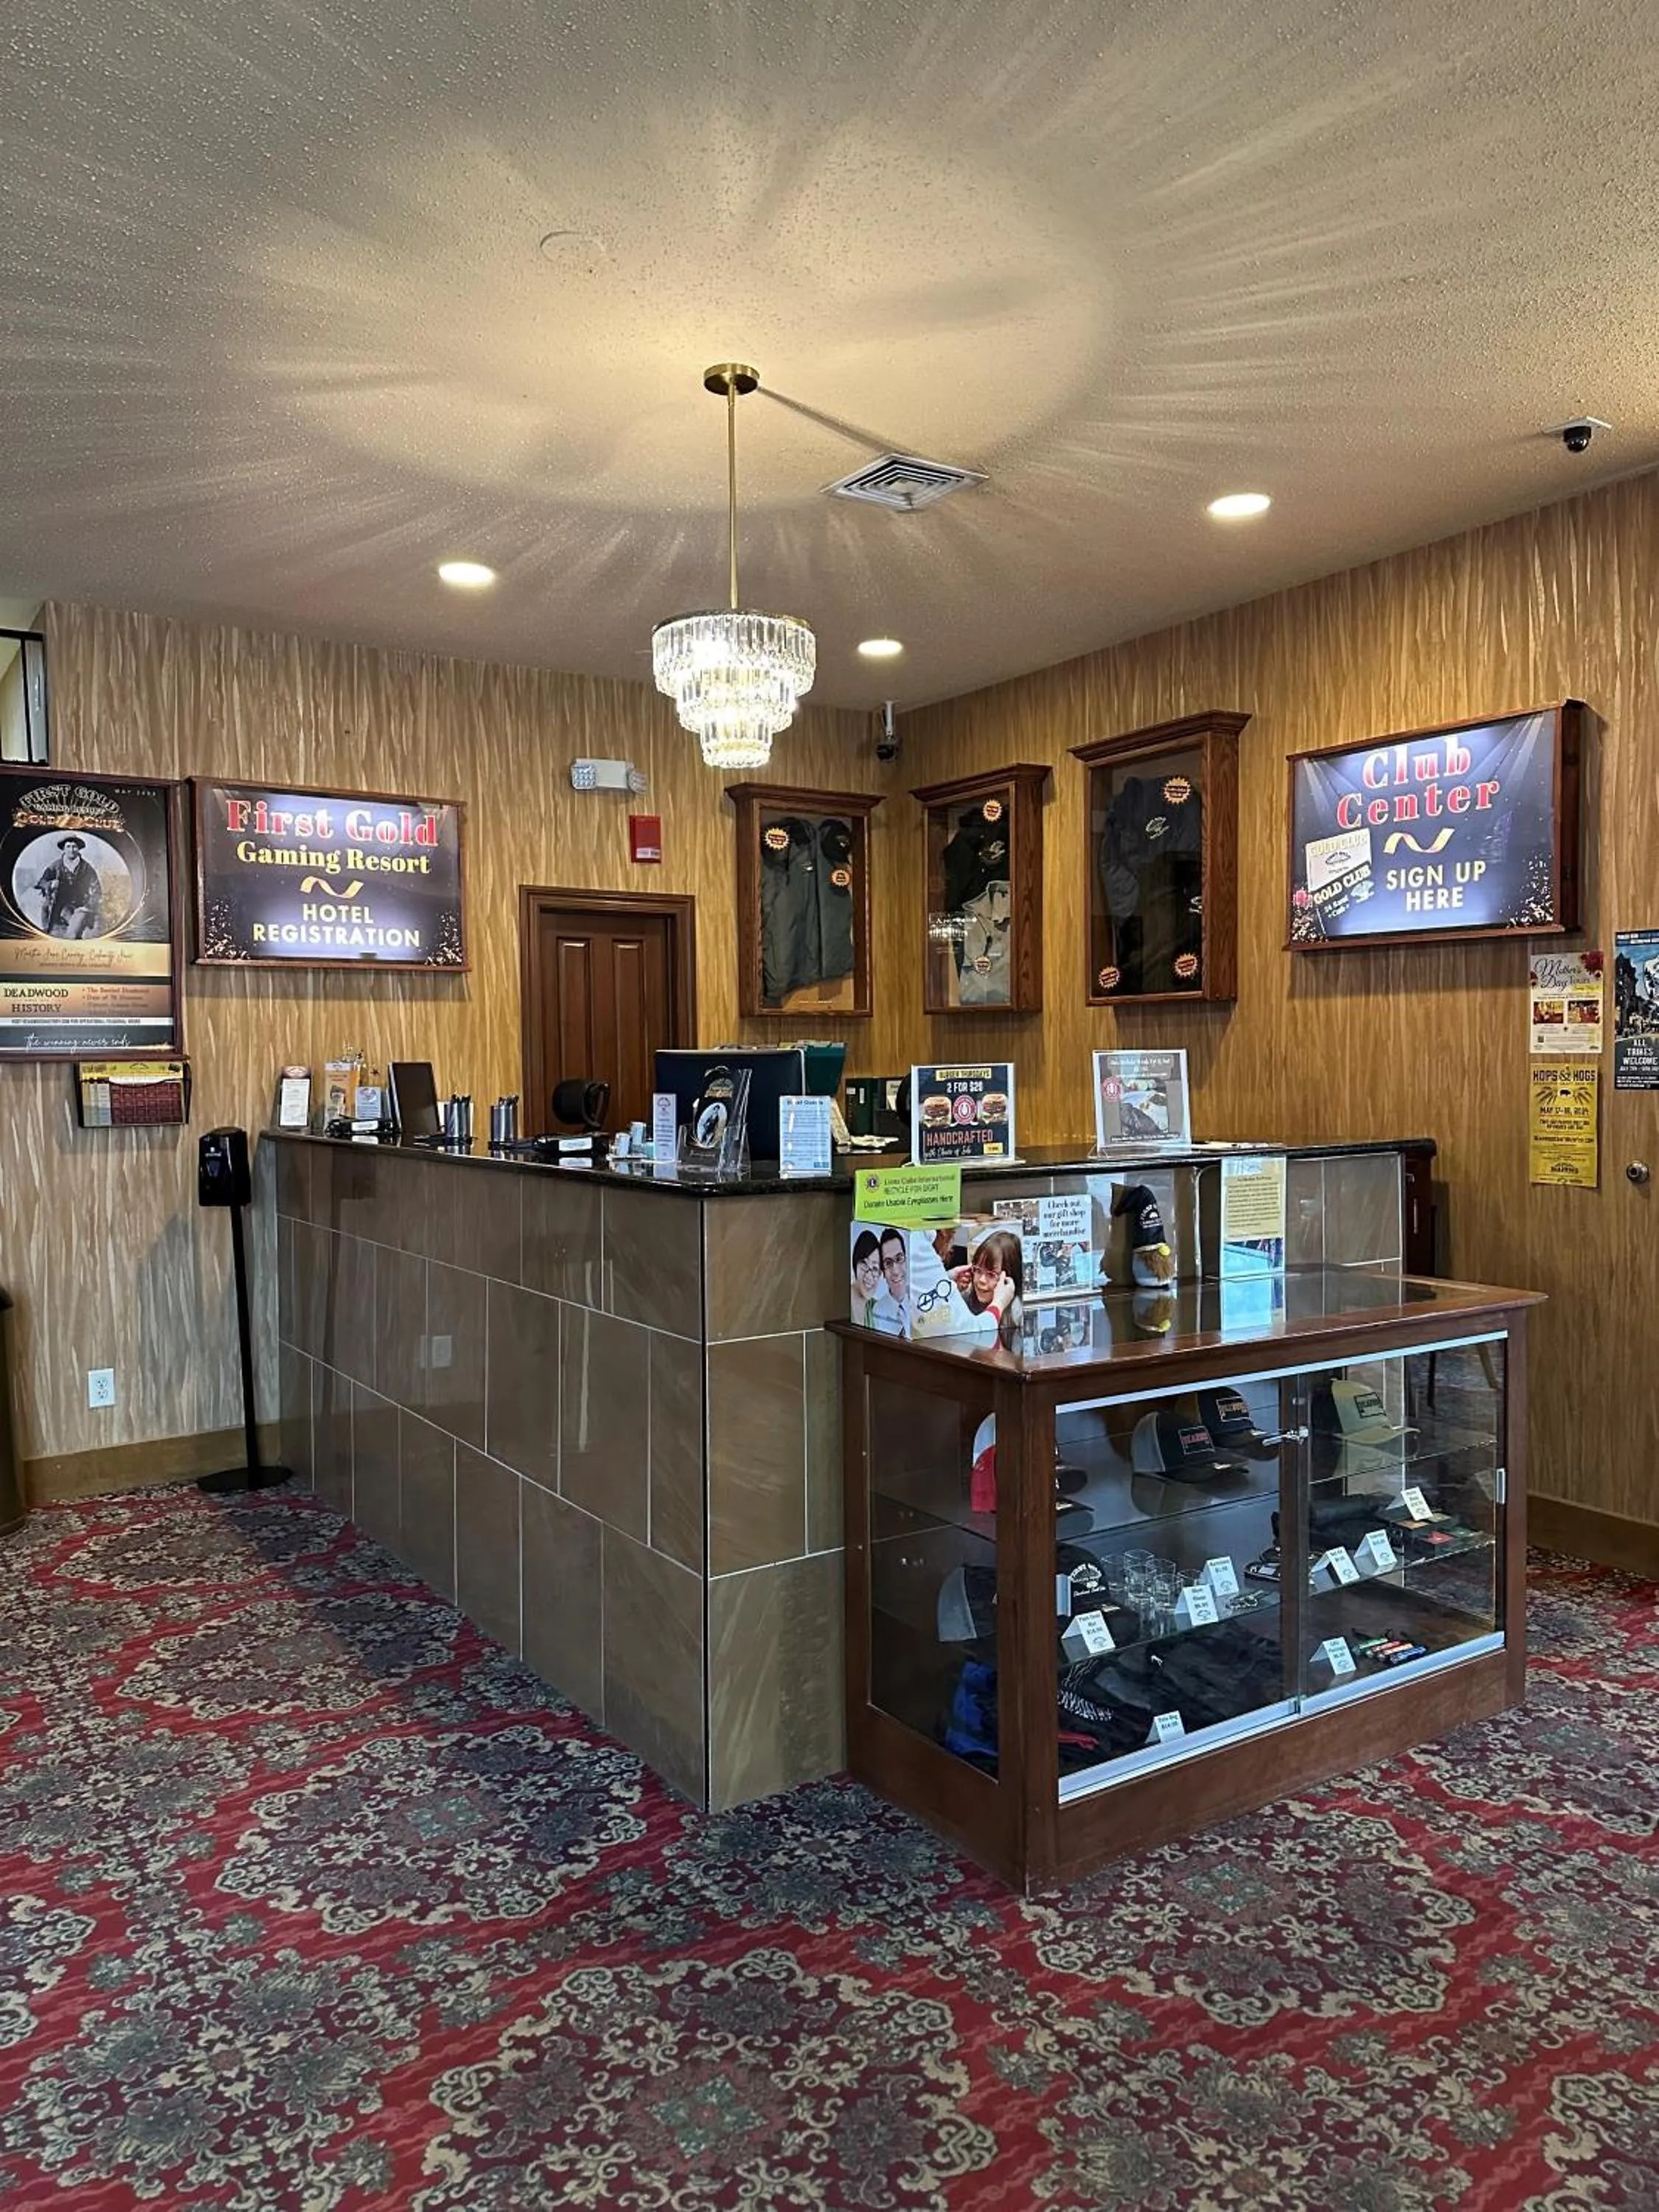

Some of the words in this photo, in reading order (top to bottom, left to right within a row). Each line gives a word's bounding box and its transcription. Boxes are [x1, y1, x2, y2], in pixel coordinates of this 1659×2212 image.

[1363, 737, 1471, 790] Club
[19, 785, 71, 808] FIRST
[74, 786, 120, 813] GOLD
[1337, 780, 1500, 830] Center
[226, 800, 333, 838] First
[345, 810, 439, 847] Gold
[237, 841, 341, 874] Gaming
[347, 849, 431, 874] Resort
[1314, 882, 1343, 905] GOLD
[1343, 864, 1371, 888] CLUB
[1385, 864, 1443, 891] SIGN
[1455, 860, 1486, 883] UP
[1406, 888, 1464, 912] HERE
[302, 903, 374, 924] HOTEL
[253, 924, 420, 947] REGISTRATION
[4, 988, 69, 998] DEADWOOD
[11, 1004, 61, 1013] HISTORY
[1623, 1057, 1658, 1065] WELCOME
[1534, 1071, 1558, 1081] HOPS
[1559, 1070, 1571, 1082] &
[1573, 1071, 1596, 1082] HOGS
[947, 1082, 952, 1093] 2
[953, 1082, 967, 1092] FOR
[927, 1130, 993, 1147] HANDCRAFTED
[1048, 1199, 1068, 1208] Check
[1057, 1208, 1068, 1219] gift
[1070, 1208, 1086, 1218] shop
[1043, 1228, 1085, 1237] merchandise
